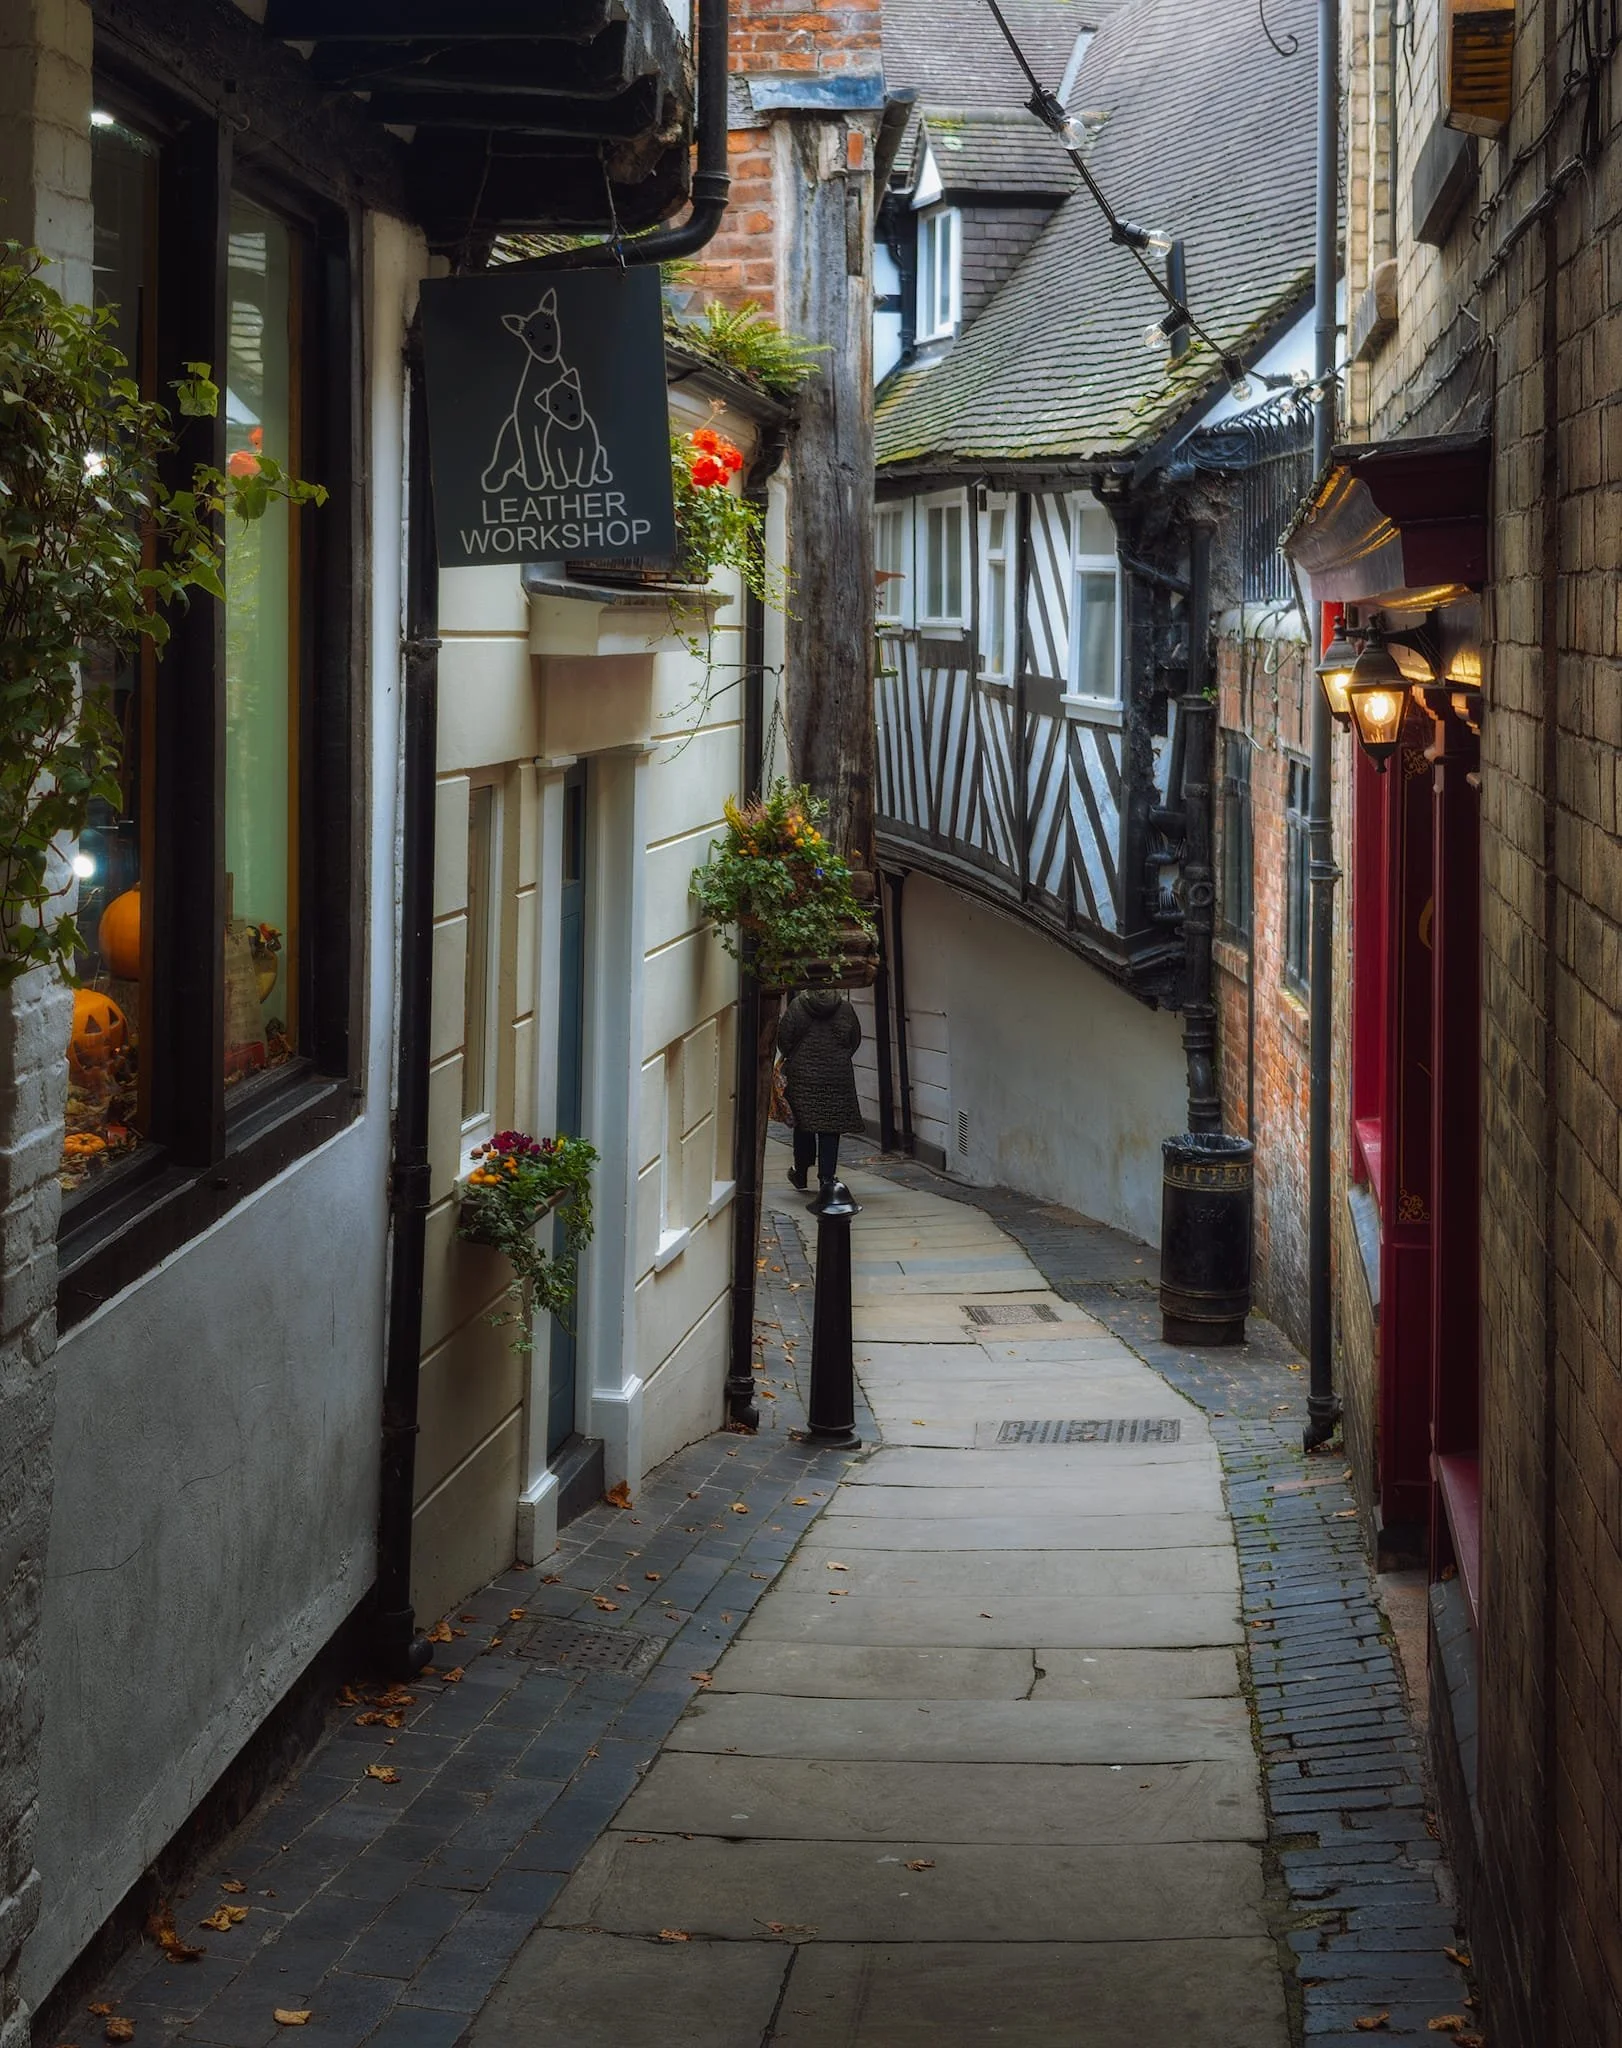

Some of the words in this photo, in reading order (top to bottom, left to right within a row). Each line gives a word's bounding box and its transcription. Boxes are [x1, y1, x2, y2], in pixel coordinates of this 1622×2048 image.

[482, 491, 628, 524] LEATHER
[460, 519, 651, 554] WORKSHOP
[1172, 1164, 1248, 1184] LITTER
